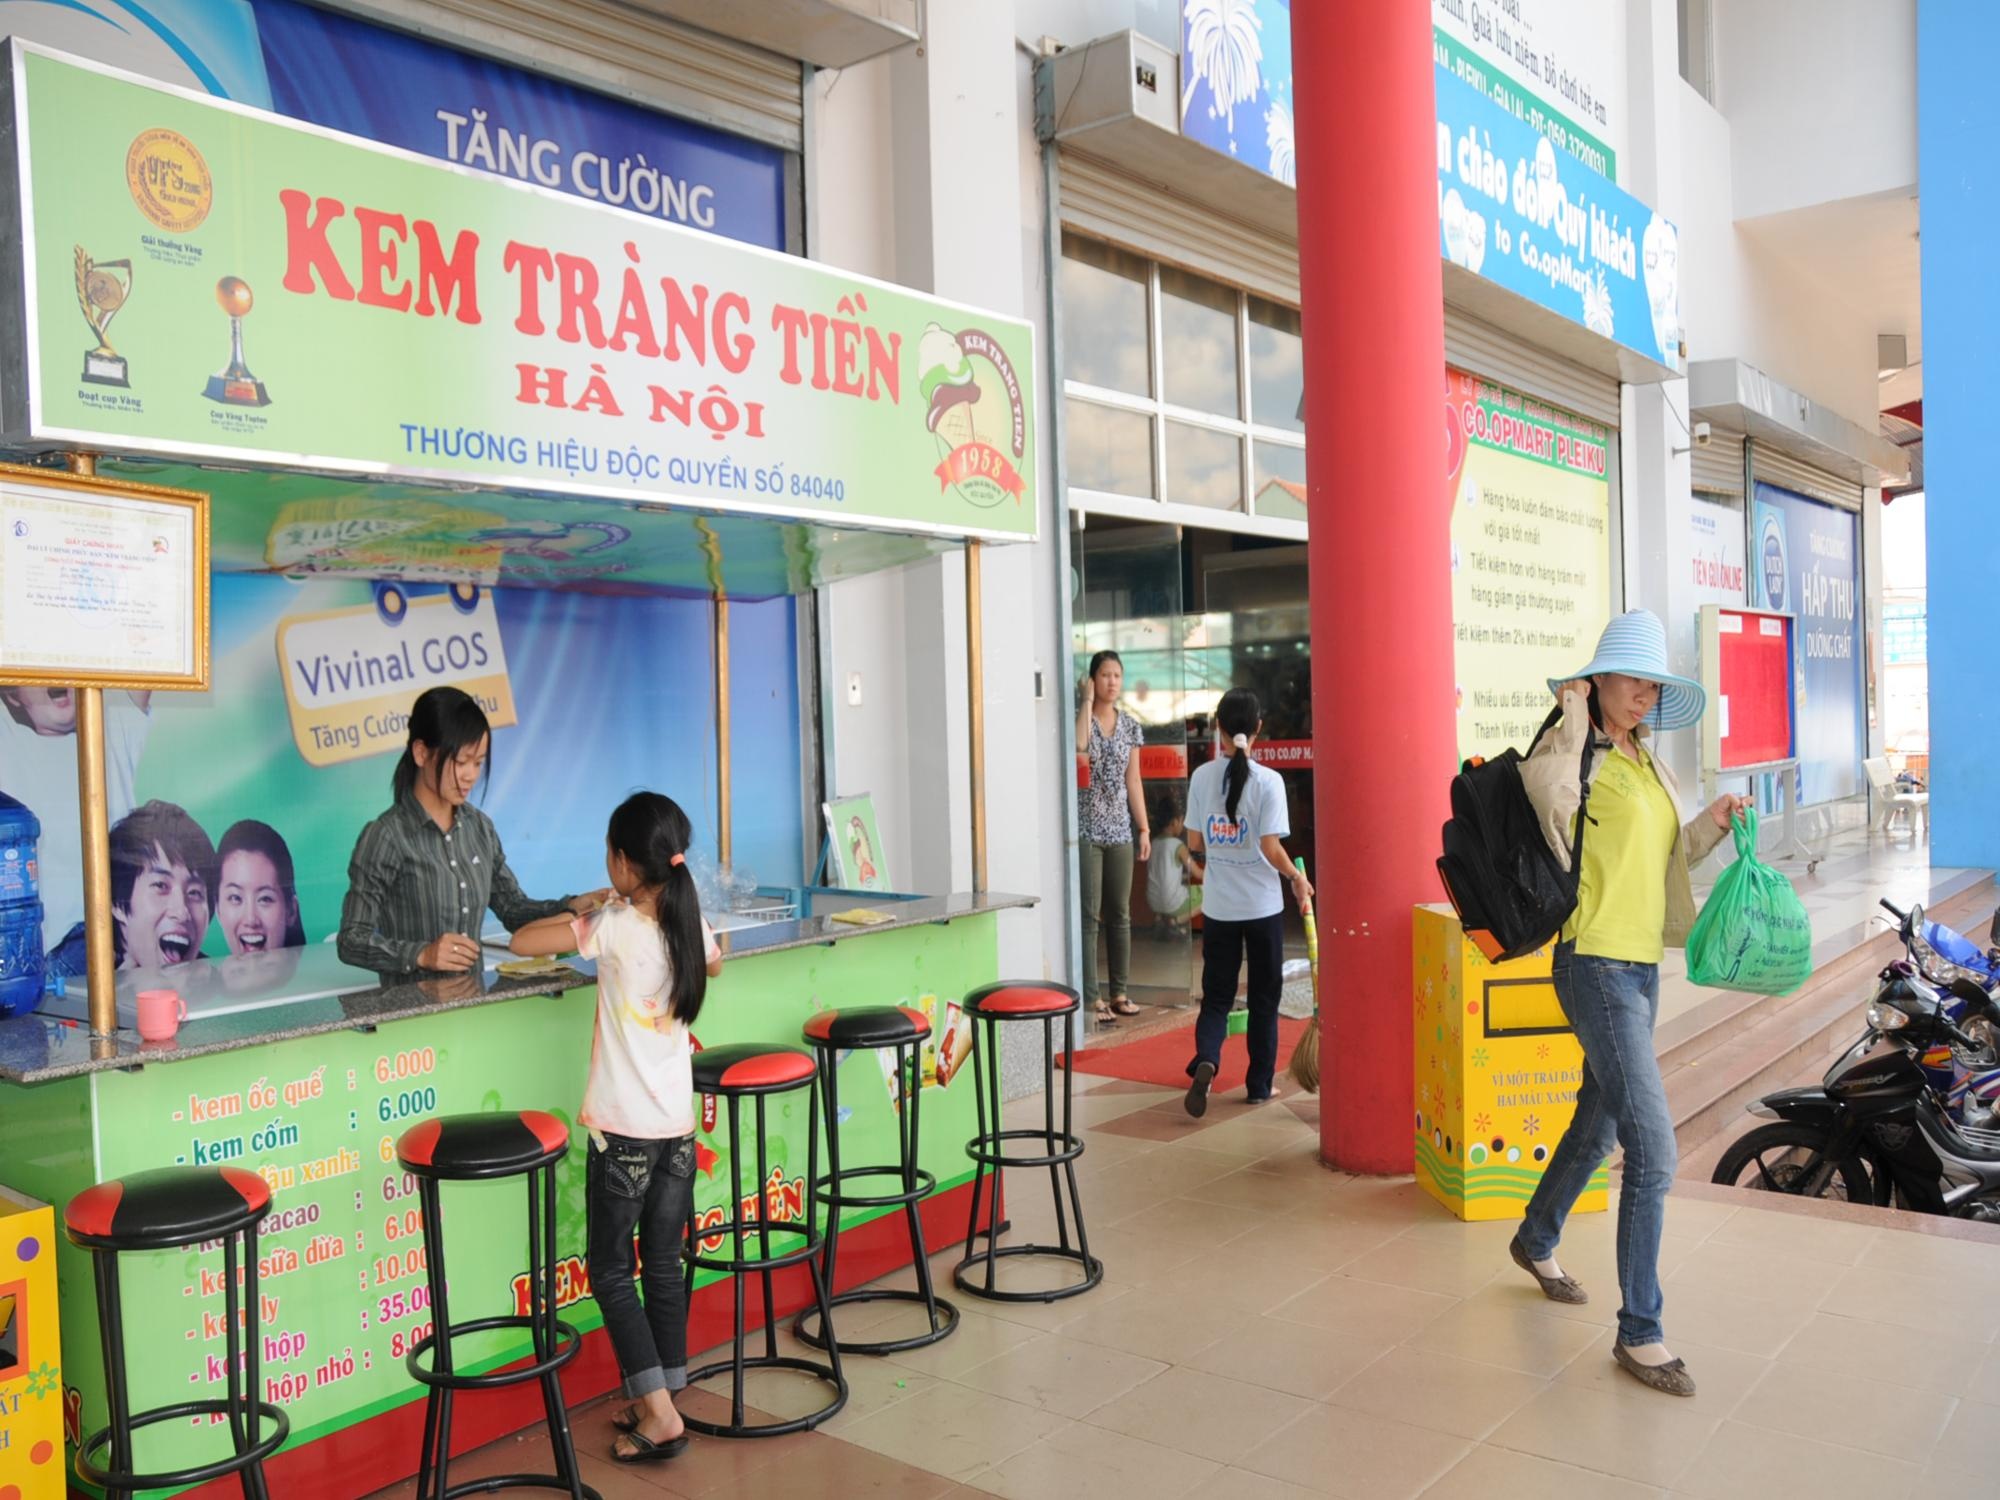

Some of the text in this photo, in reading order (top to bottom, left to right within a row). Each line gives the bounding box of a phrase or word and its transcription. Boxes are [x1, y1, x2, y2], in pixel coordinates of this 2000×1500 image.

[1472, 1, 1492, 42] Quà
[1495, 17, 1511, 56] lưu
[1595, 98, 1607, 127] em
[436, 107, 716, 229] TĂNG CƯỜNG
[1457, 124, 1508, 205] chào
[1590, 203, 1636, 280] khách
[1495, 219, 1512, 255] to
[279, 188, 902, 406] KEM TRÀNG TIỀN
[78, 390, 99, 403] Đoạt
[102, 395, 117, 404] cup
[515, 361, 766, 441] HÀ NỘI
[964, 335, 1023, 449] KEM TRANG TIEN
[400, 422, 845, 502] THƯƠNG HIỆU ĐỘC QUYỀN SỐ 84040
[960, 447, 1002, 478] 1958
[1463, 401, 1607, 476] CO.OPMART PLEIKU
[1802, 560, 1828, 617] HẤP
[296, 631, 488, 696] Vivinal GOS
[310, 695, 498, 750] Tăng Cườn hu
[1264, 749, 1275, 760] TO
[1277, 747, 1302, 760] CO.OP
[191, 1047, 435, 1123] kem ốc quế 6.000
[1492, 1070, 1504, 1087] VÌ
[1506, 1069, 1530, 1088] MỘT
[1497, 1093, 1517, 1107] HAI
[1547, 1089, 1579, 1105] XANH
[193, 1086, 437, 1166] kem cốm 6.000
[257, 1202, 320, 1236] cacao
[258, 1247, 298, 1279] sữa
[305, 1234, 345, 1267] dừa
[260, 1295, 279, 1325] ly
[373, 1245, 428, 1286] 10.00
[263, 1331, 306, 1363] hộp
[265, 1372, 308, 1405] hộp
[316, 1347, 355, 1386] nhỏ
